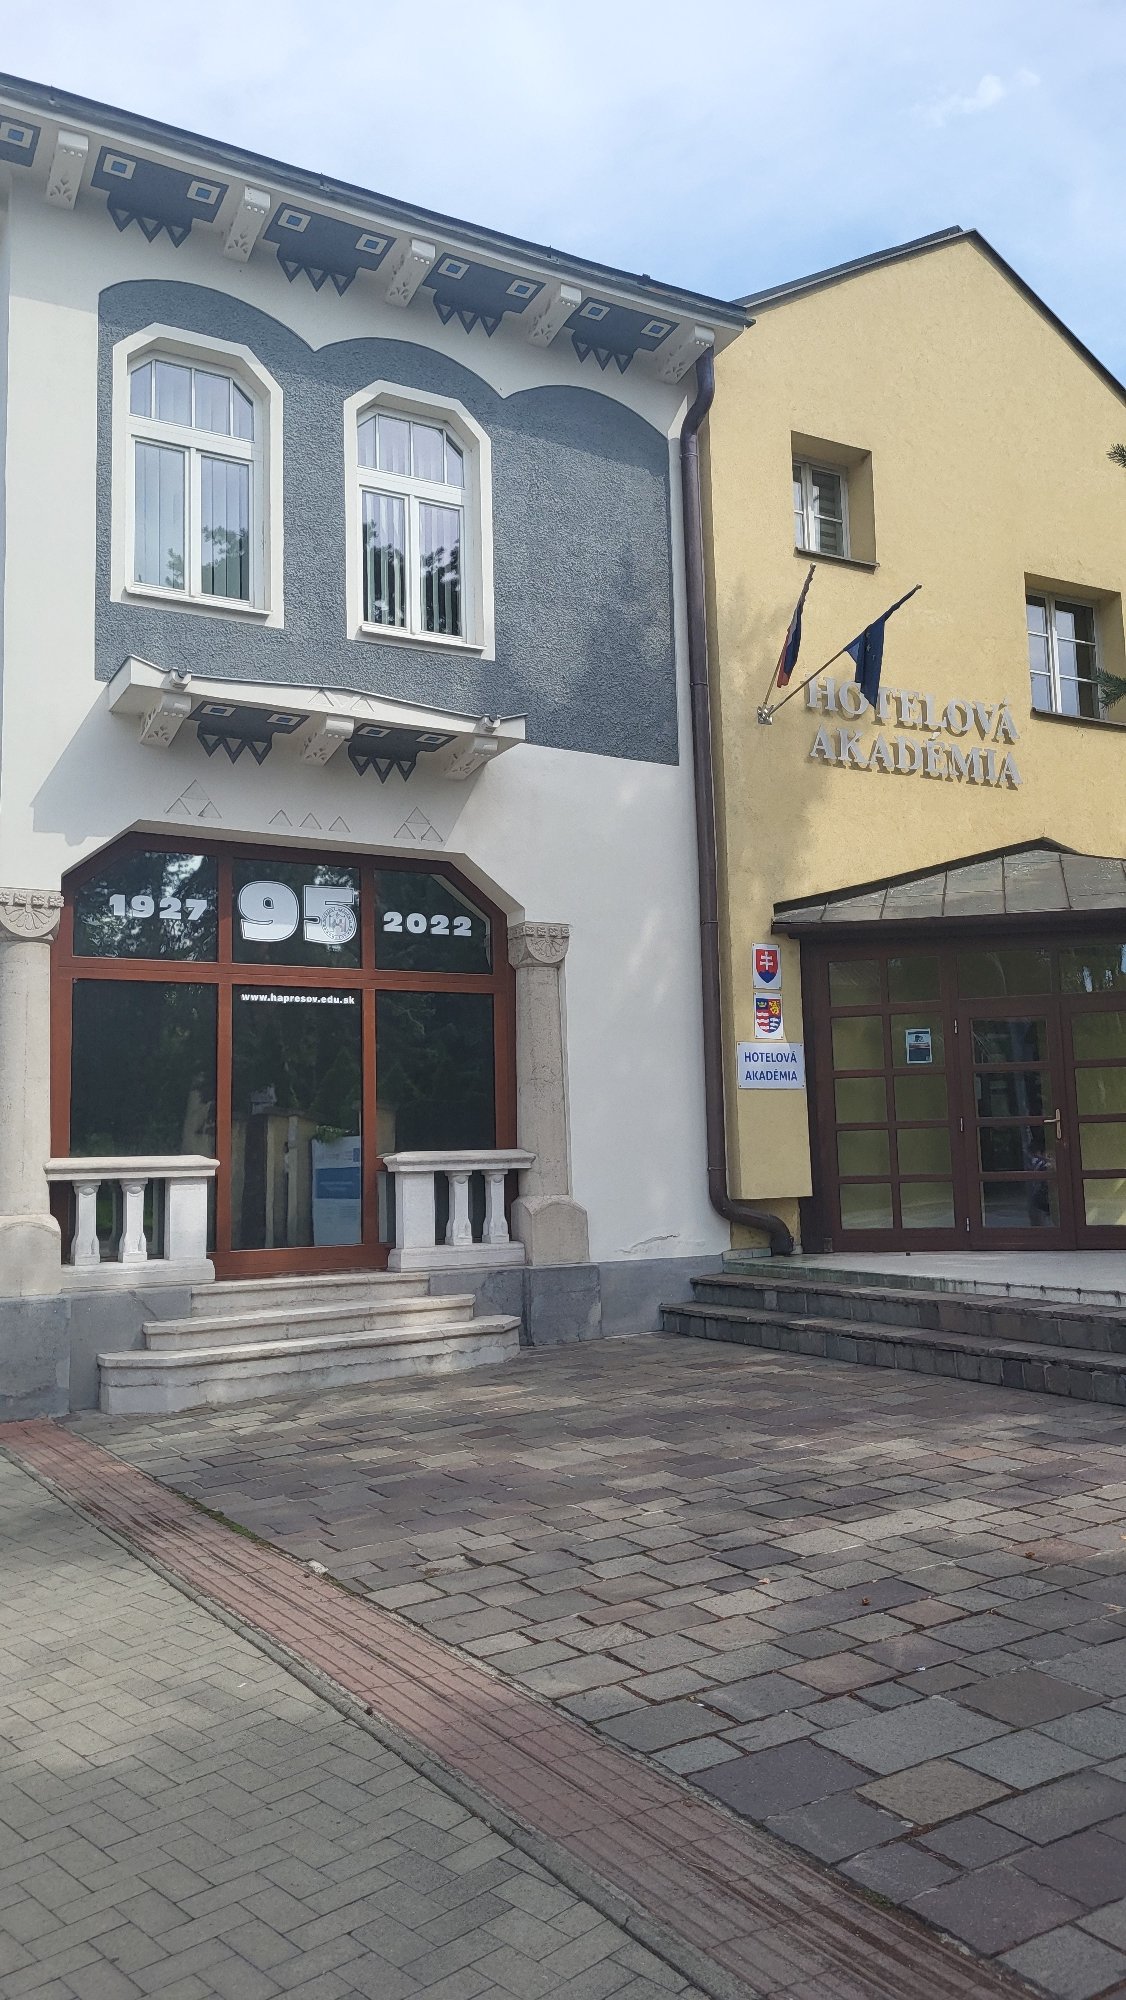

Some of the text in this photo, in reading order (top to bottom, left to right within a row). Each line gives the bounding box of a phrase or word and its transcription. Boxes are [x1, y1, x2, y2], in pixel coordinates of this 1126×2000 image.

[804, 674, 1020, 740] HOTELOVÁ
[809, 723, 1024, 785] AKADÉMIA
[108, 893, 208, 922] 1927
[238, 880, 358, 944] 95
[382, 911, 473, 938] 2022
[241, 993, 355, 1005] www.hapresov.edu.sk
[744, 1050, 798, 1063] HOTELOVÁ
[744, 1068, 798, 1081] AKADÉMIA
